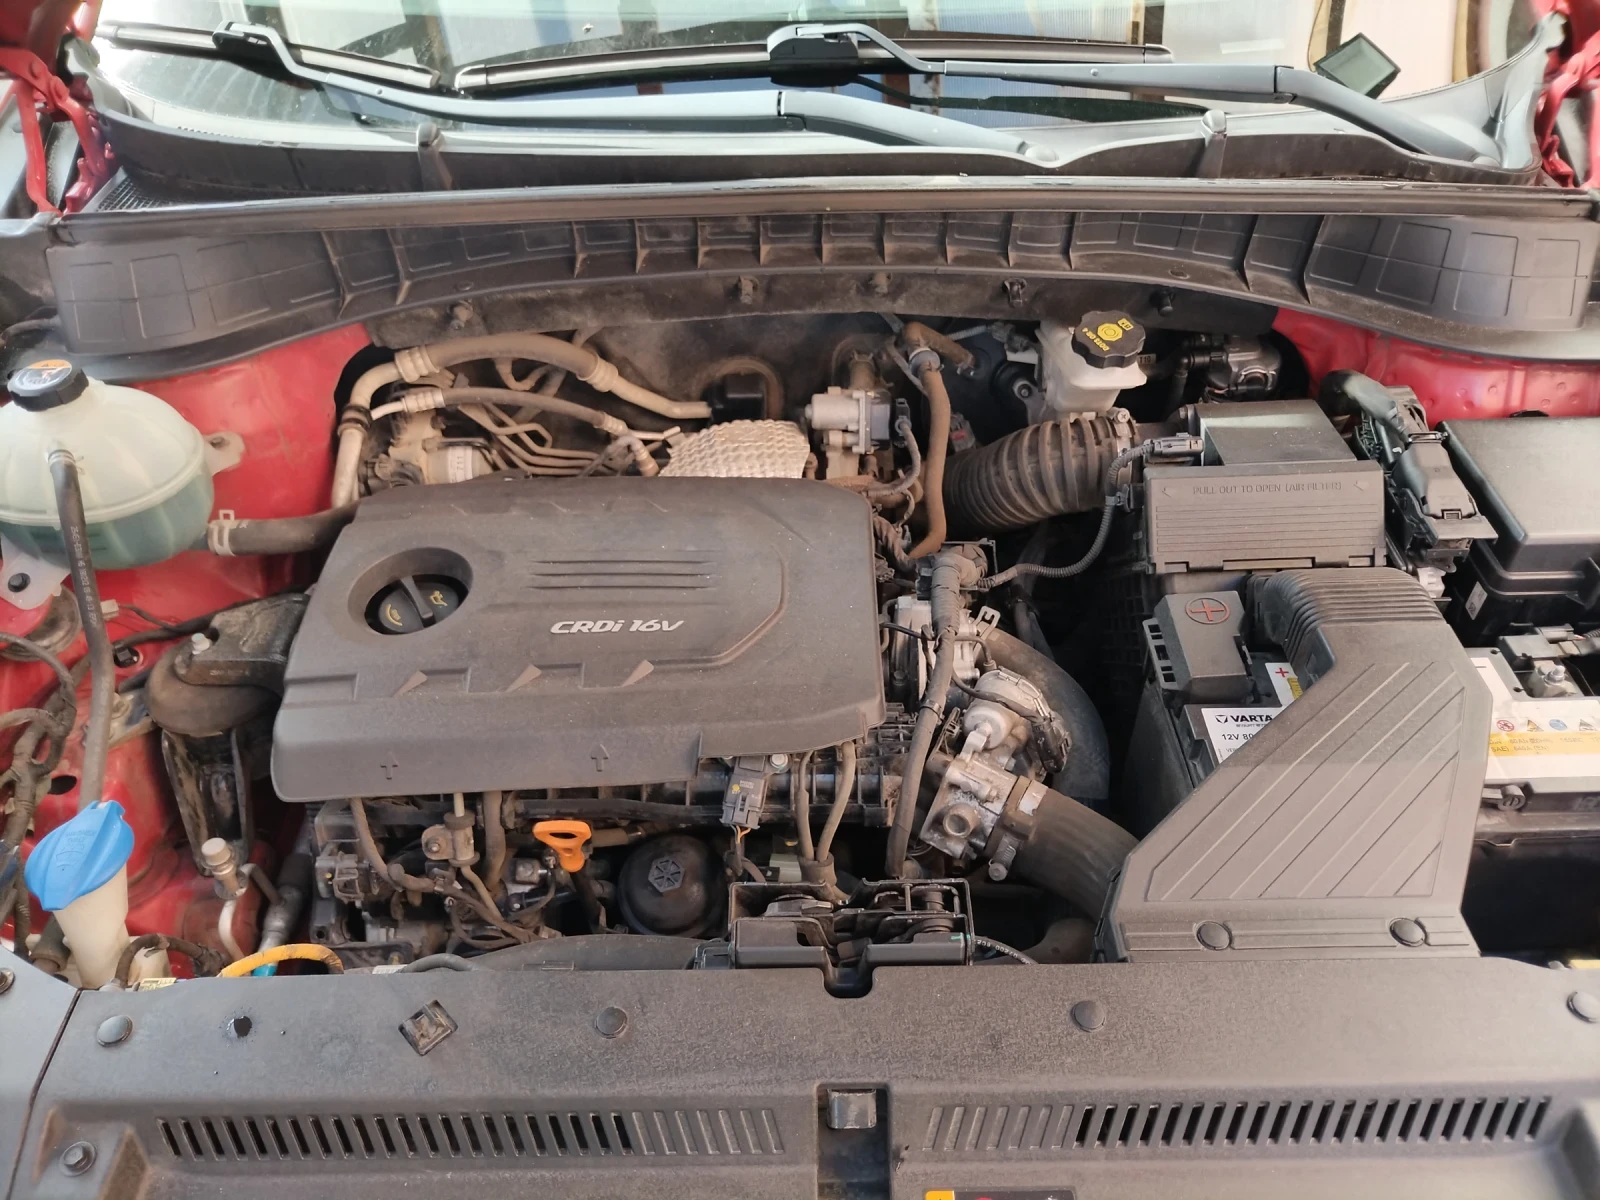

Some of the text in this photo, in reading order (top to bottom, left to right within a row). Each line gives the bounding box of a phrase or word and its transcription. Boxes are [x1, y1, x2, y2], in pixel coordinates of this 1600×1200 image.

[1193, 486, 1215, 495] PULL
[1219, 485, 1237, 494] OUT
[1241, 485, 1253, 493] TO
[1255, 484, 1281, 493] OPEN
[550, 619, 685, 634] CRDi 16V
[1230, 714, 1273, 723] VARTA
[1222, 733, 1240, 741] 12V
